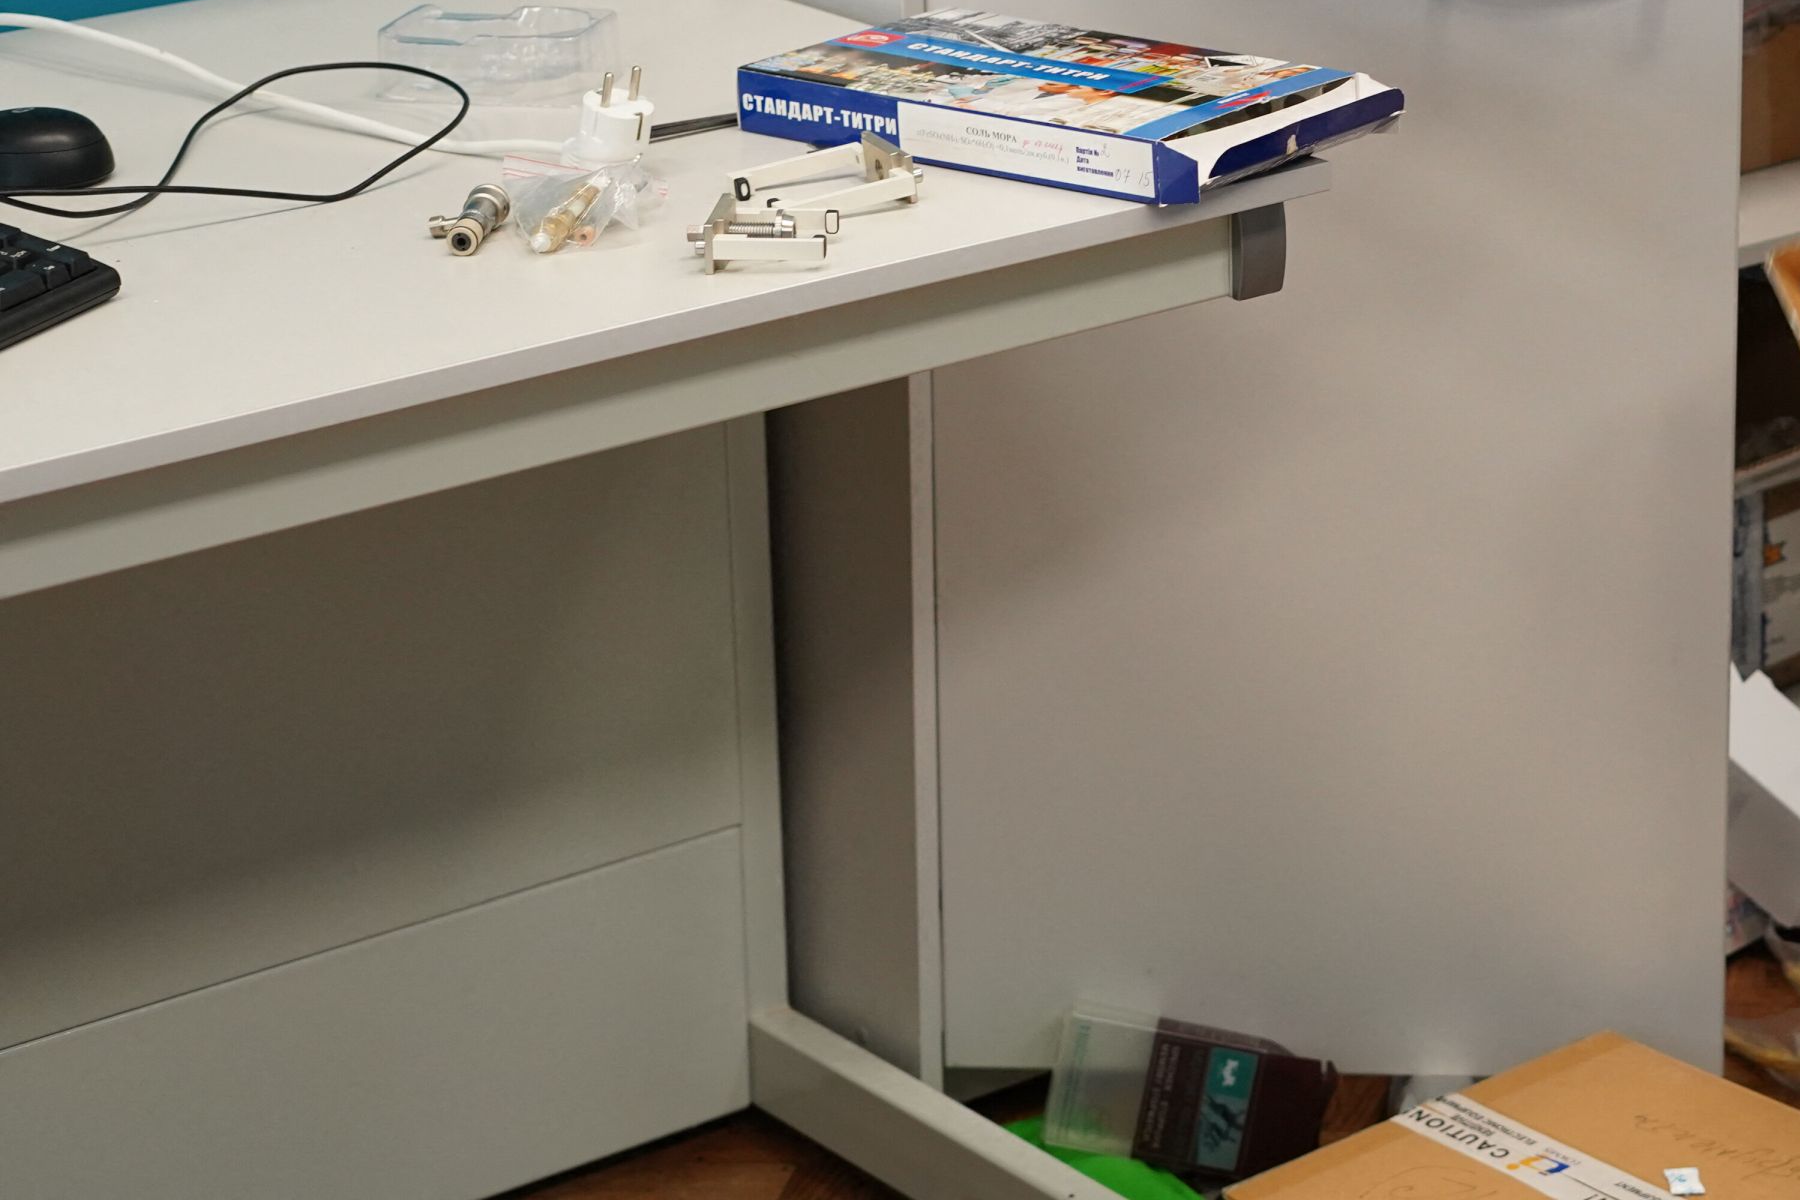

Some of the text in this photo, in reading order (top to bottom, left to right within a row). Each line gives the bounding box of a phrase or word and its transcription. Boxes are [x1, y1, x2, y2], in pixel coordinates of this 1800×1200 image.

[906, 41, 1112, 82] СТАНДАРТ-ТИТРИ
[741, 92, 898, 136] СТАНДАРТ-ТИТРИ
[965, 126, 991, 139] СОЛЬ
[992, 130, 1018, 144] МОРА
